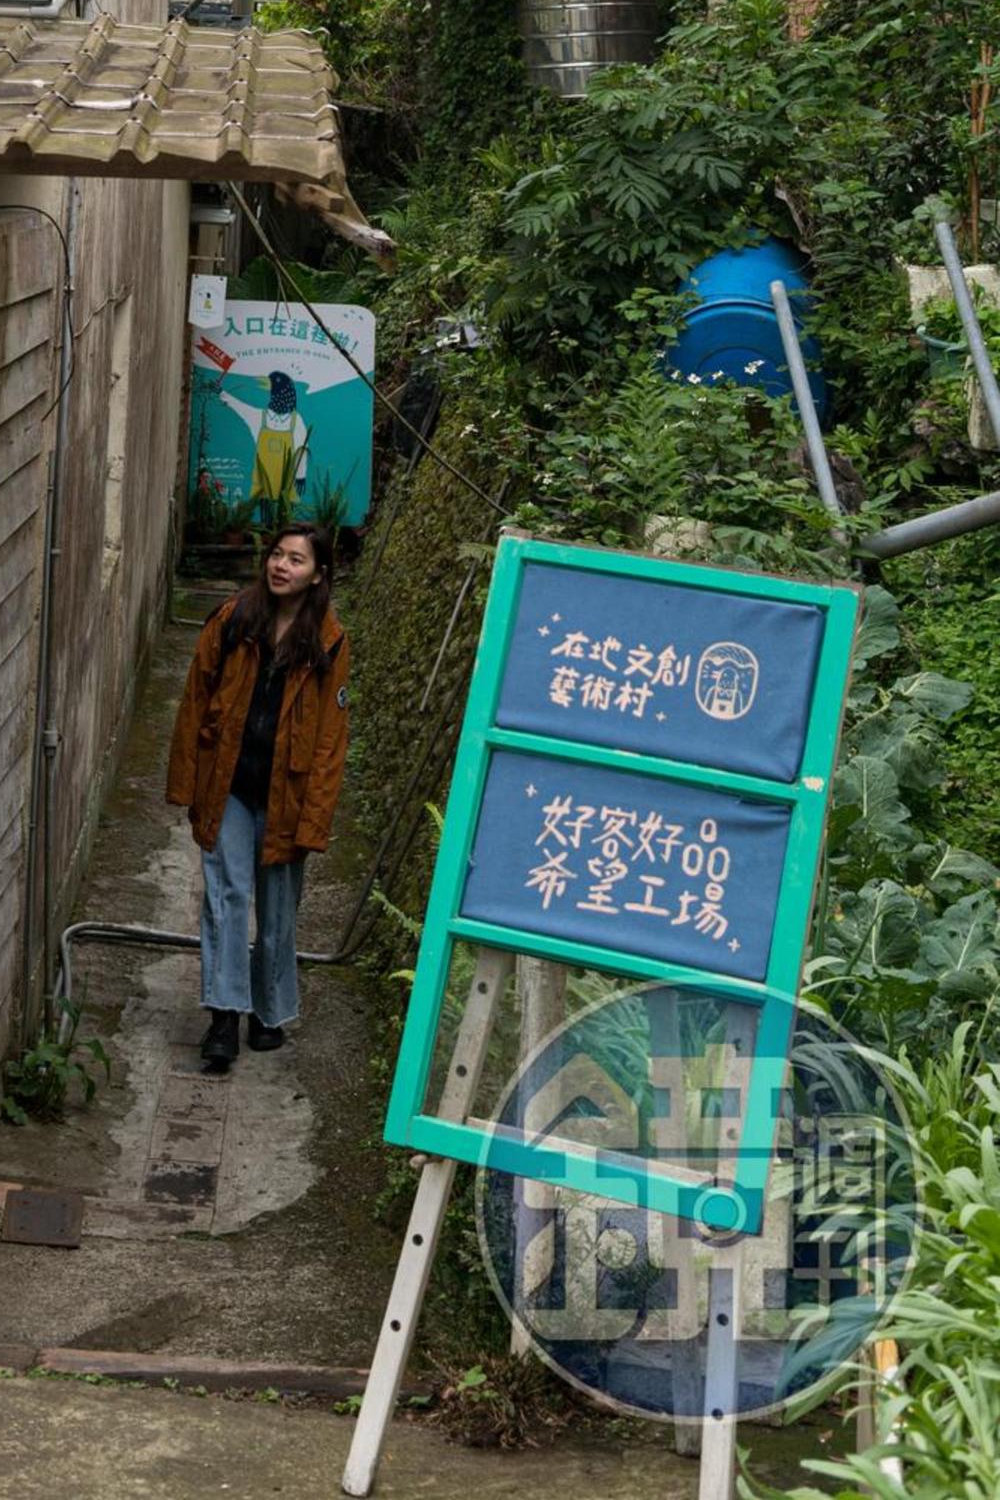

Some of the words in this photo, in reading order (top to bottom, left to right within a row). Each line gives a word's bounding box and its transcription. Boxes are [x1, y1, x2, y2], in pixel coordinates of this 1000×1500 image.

[549, 665, 654, 719] 藝術村
[551, 631, 690, 688] 在地文創
[535, 795, 731, 883] 好客好品
[524, 848, 729, 941] 希望工場
